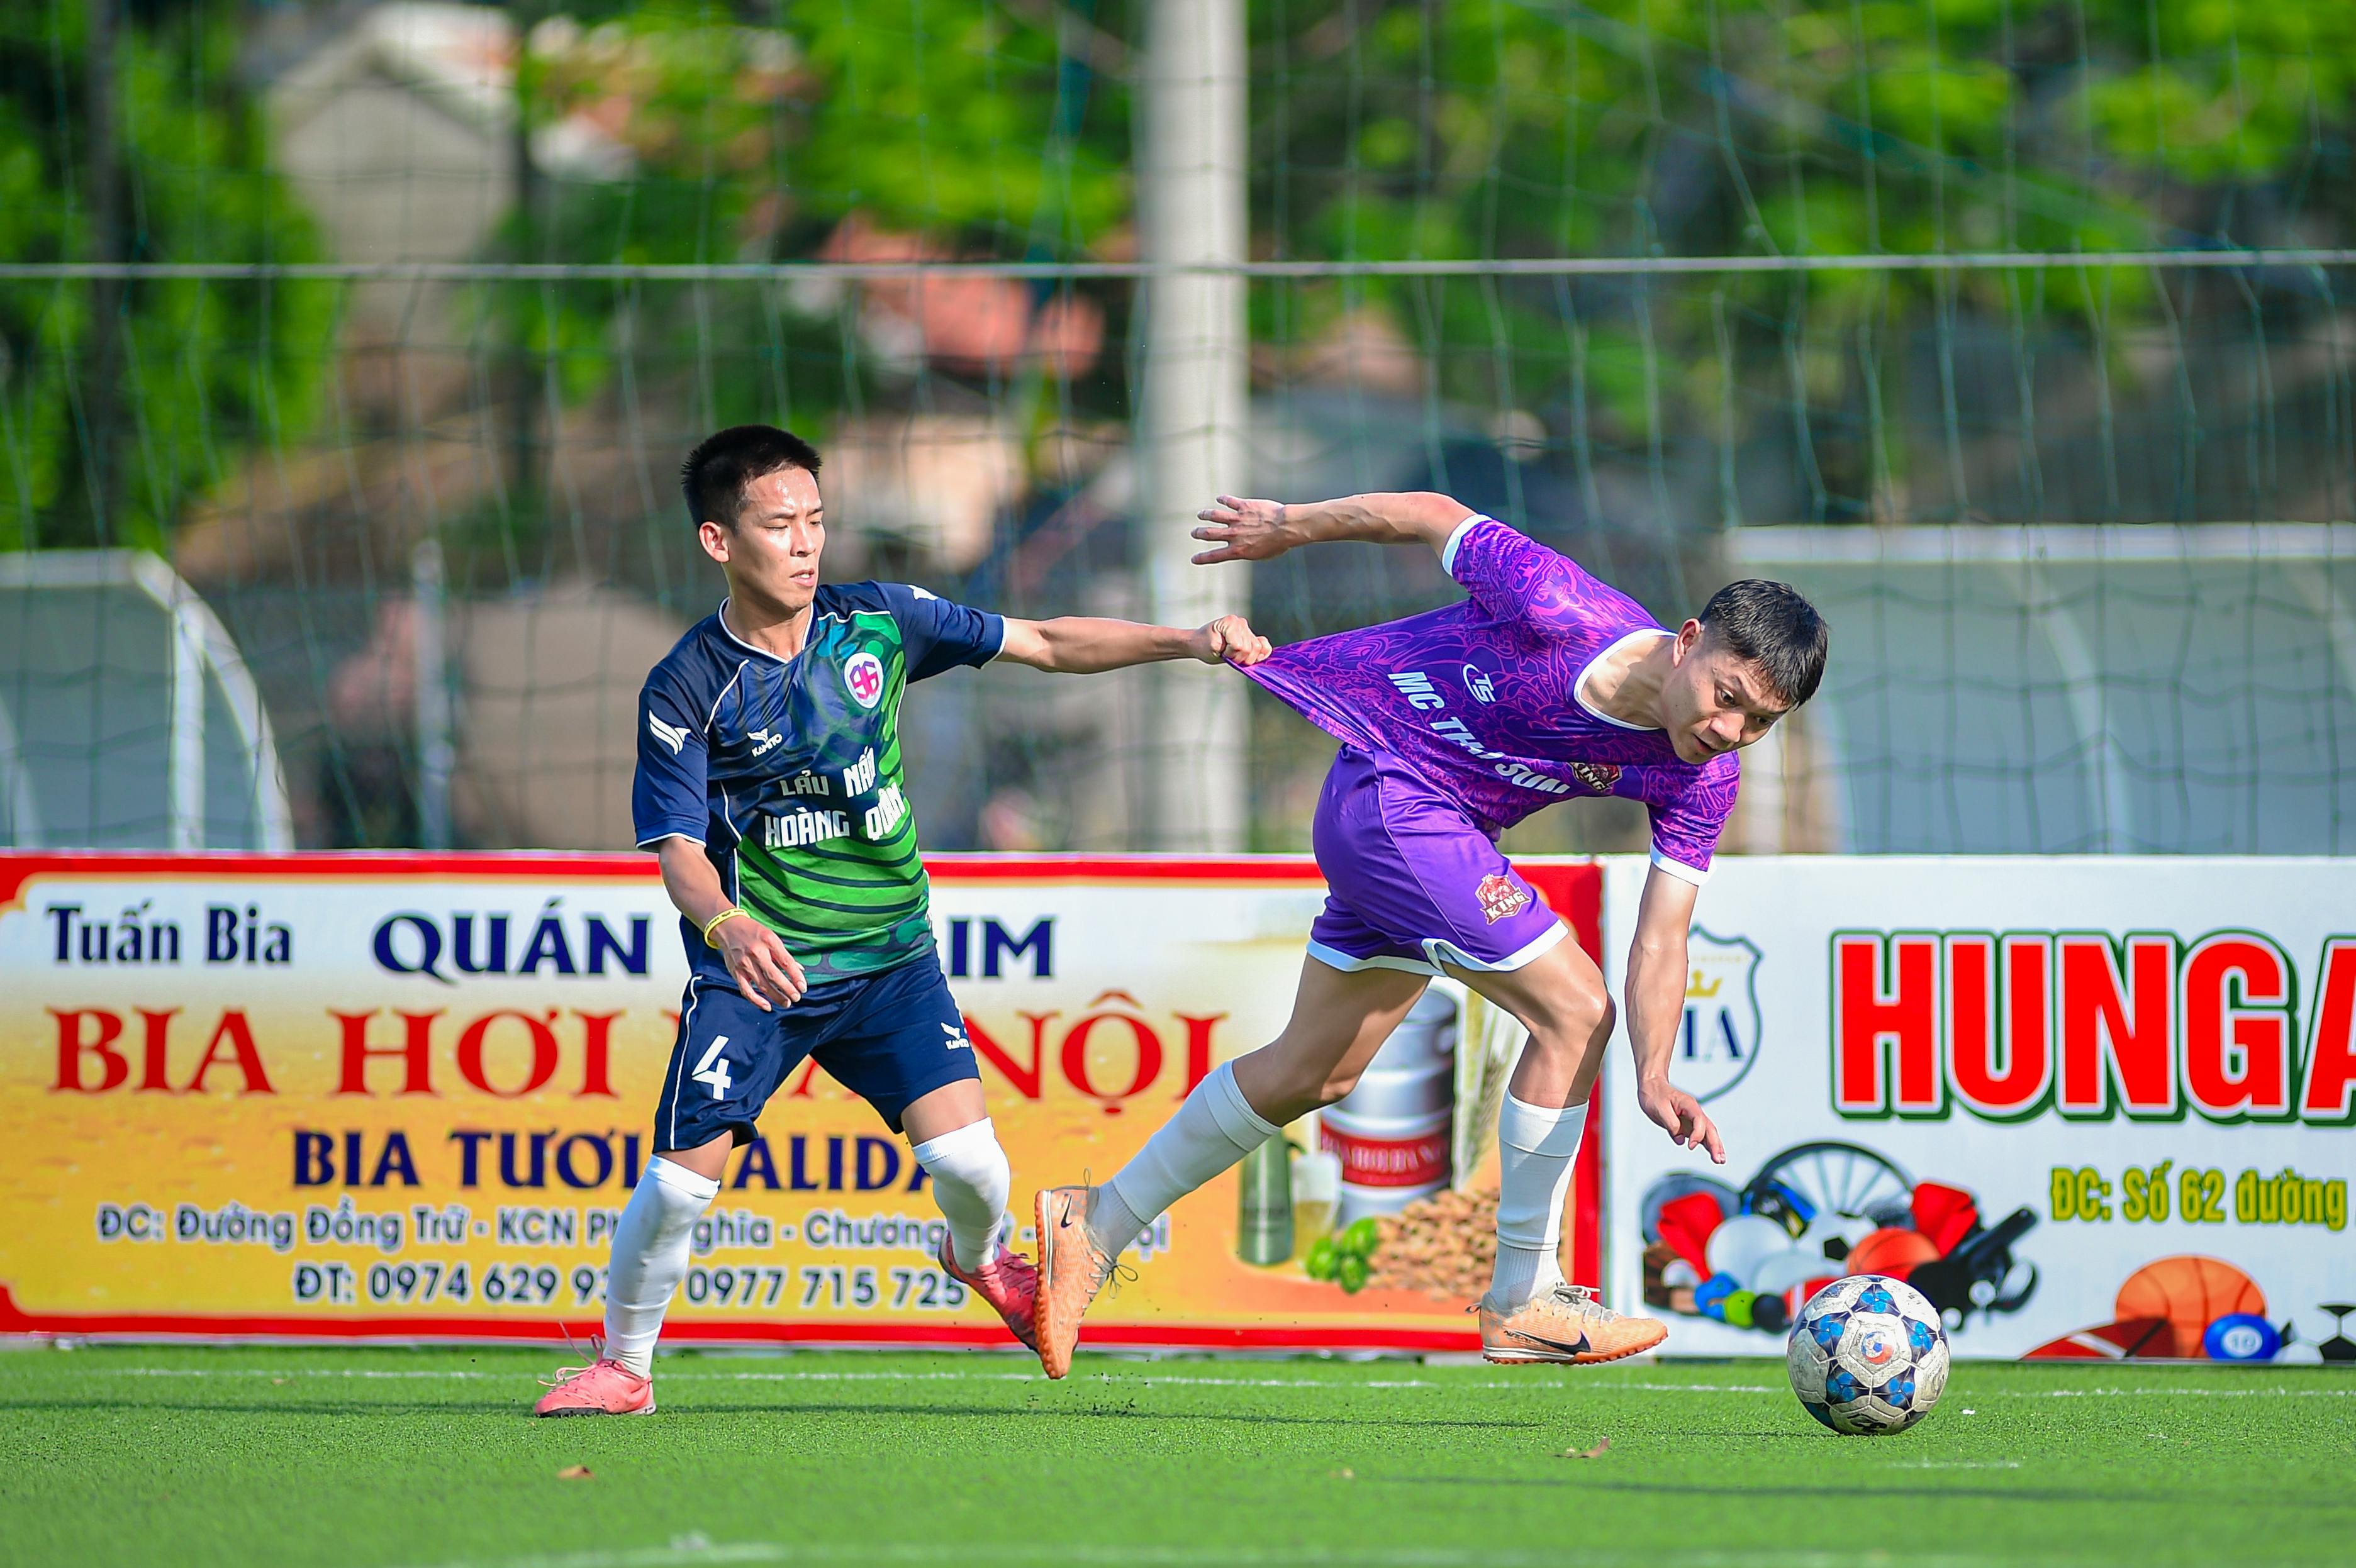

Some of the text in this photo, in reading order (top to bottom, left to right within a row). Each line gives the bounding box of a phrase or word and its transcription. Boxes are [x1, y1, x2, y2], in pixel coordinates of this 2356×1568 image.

[1387, 672, 1445, 709] MC
[764, 806, 850, 847] HOÀNG
[1485, 891, 1526, 920] KING
[47, 896, 1057, 988] Tuấn Bia QUÁN IM
[46, 1006, 277, 1096] BIA
[327, 1004, 628, 1099] HƠI
[692, 1035, 732, 1101] 4
[293, 1128, 931, 1191] BIA TƯƠI ALID
[2049, 1159, 2347, 1232] ĐC: Số 62 đường
[99, 1206, 164, 1240] ĐC:
[178, 1201, 293, 1250] Đường
[500, 1209, 574, 1243] KCN
[693, 1211, 770, 1255] ghĩa
[296, 1264, 352, 1301] ĐT:
[371, 1265, 467, 1301] 0974
[484, 1267, 557, 1301] 629
[688, 1269, 783, 1304] 0977
[803, 1270, 875, 1305] 715
[893, 1271, 965, 1305] 725
